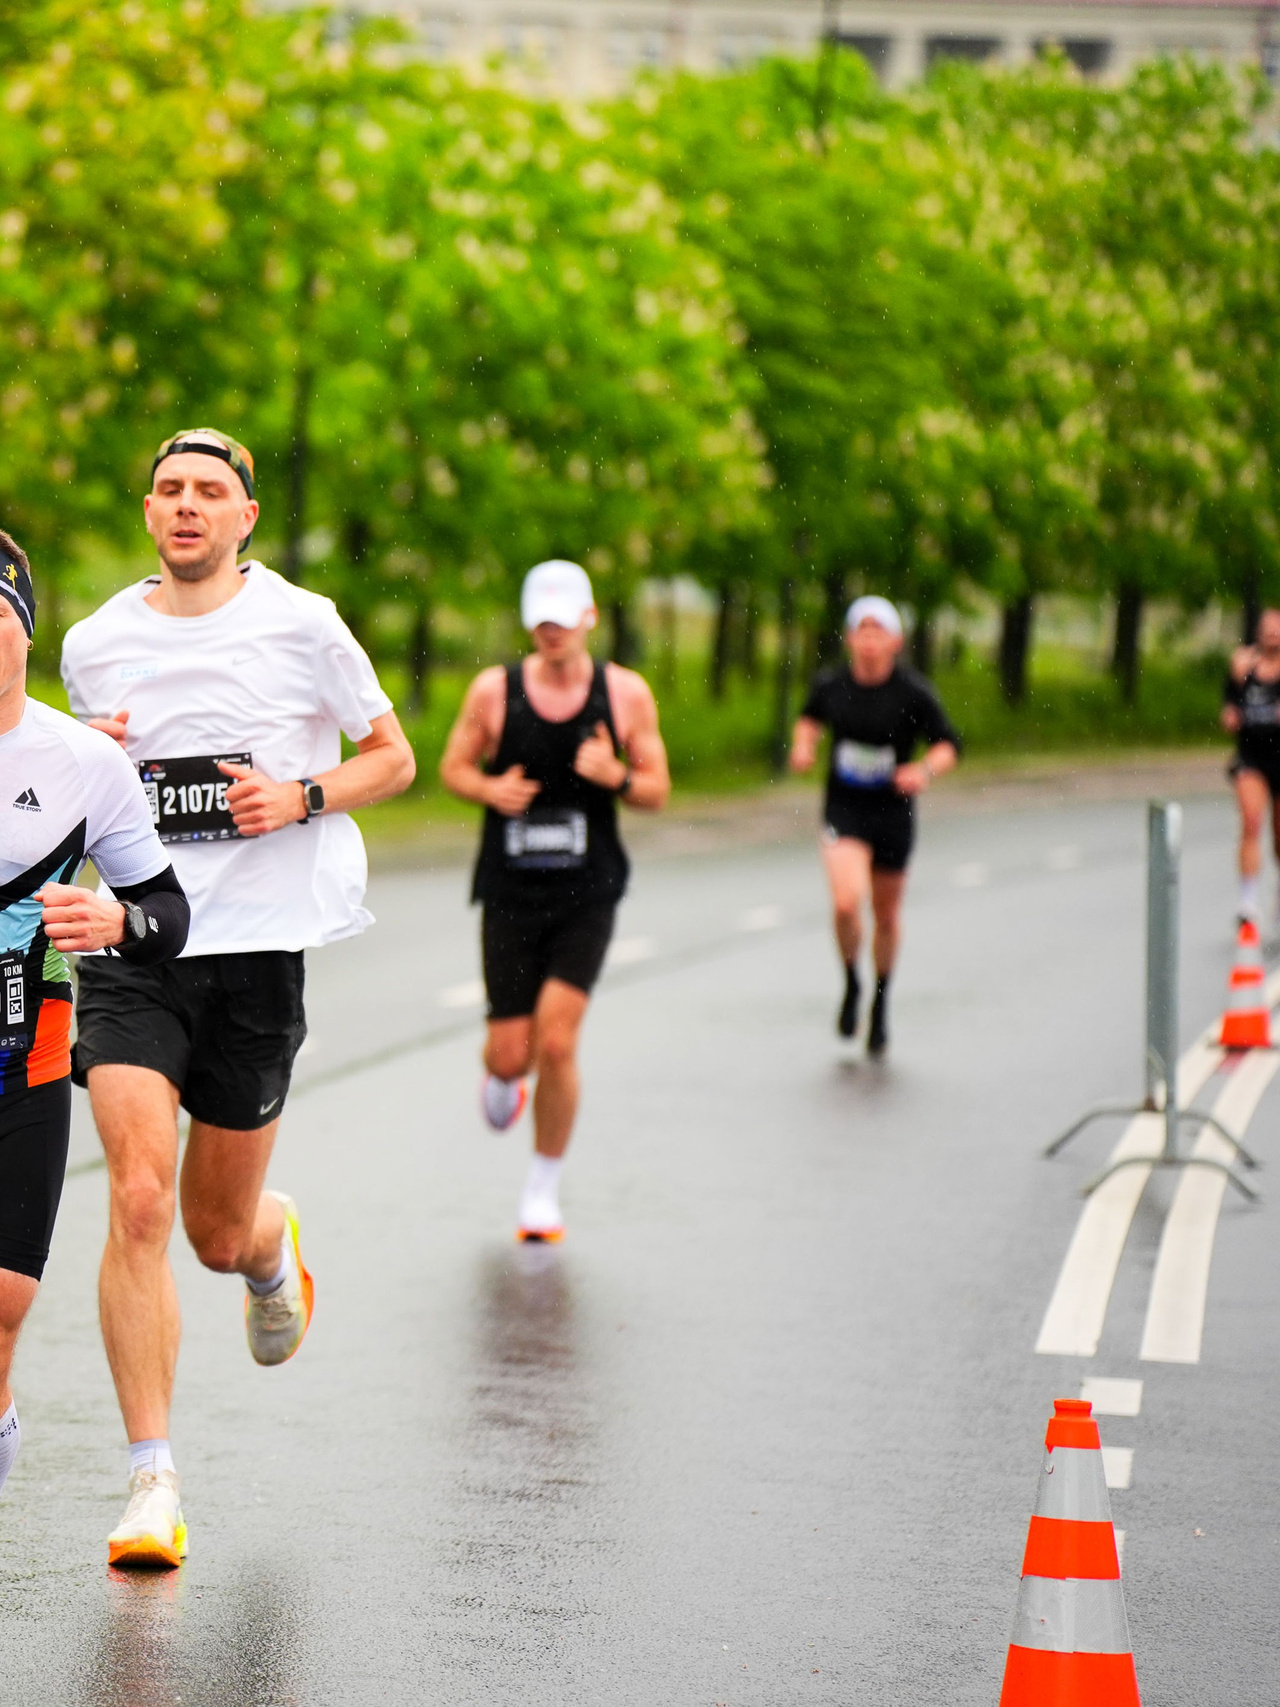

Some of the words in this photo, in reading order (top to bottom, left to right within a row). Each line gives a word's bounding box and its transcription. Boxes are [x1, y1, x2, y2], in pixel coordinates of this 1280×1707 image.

[162, 782, 230, 815] 21075
[4, 966, 12, 977] 10
[12, 964, 23, 976] KM
